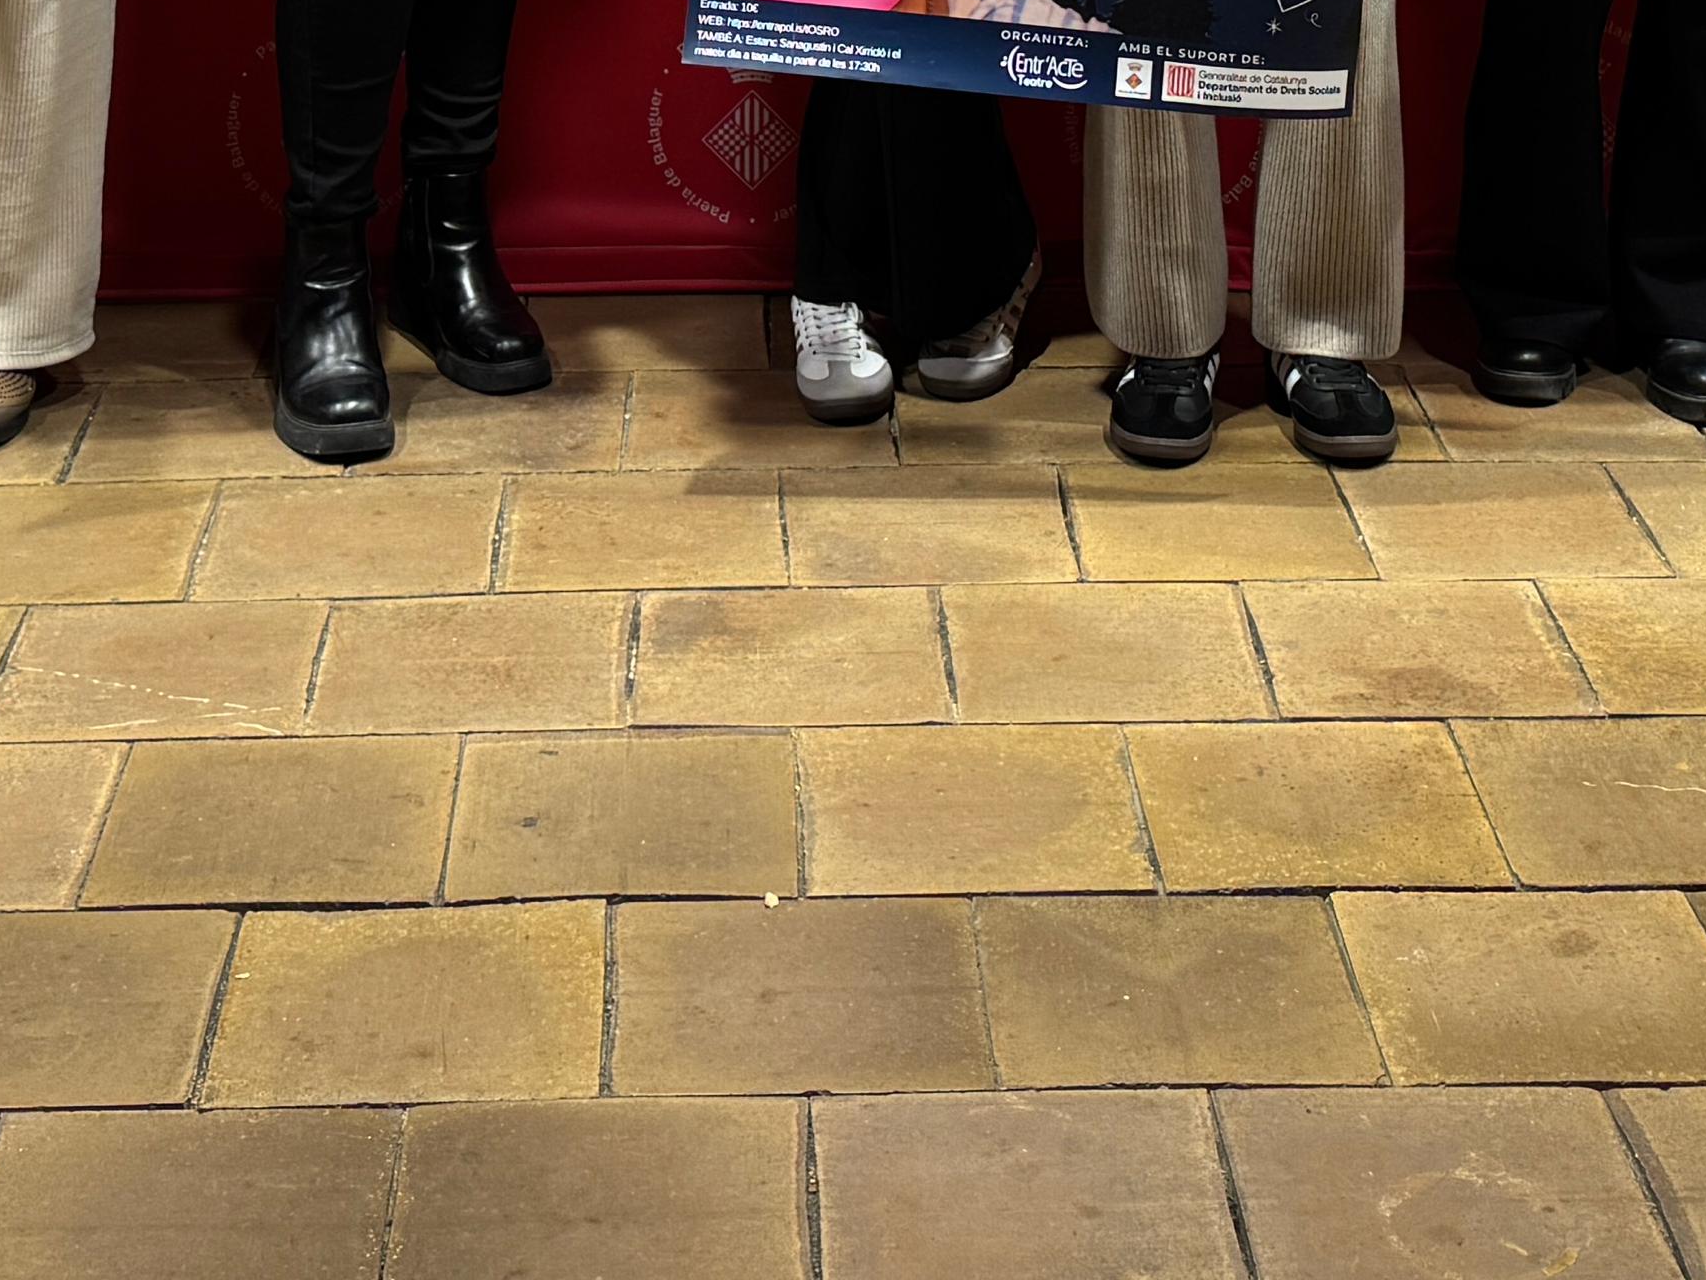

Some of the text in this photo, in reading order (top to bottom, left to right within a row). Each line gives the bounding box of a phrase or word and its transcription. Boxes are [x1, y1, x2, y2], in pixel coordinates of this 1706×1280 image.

[1000, 30, 1089, 48] ORGANITZA:
[1118, 41, 1266, 65] AMB EL SUPORT DE:
[1017, 76, 1053, 89] Teatre
